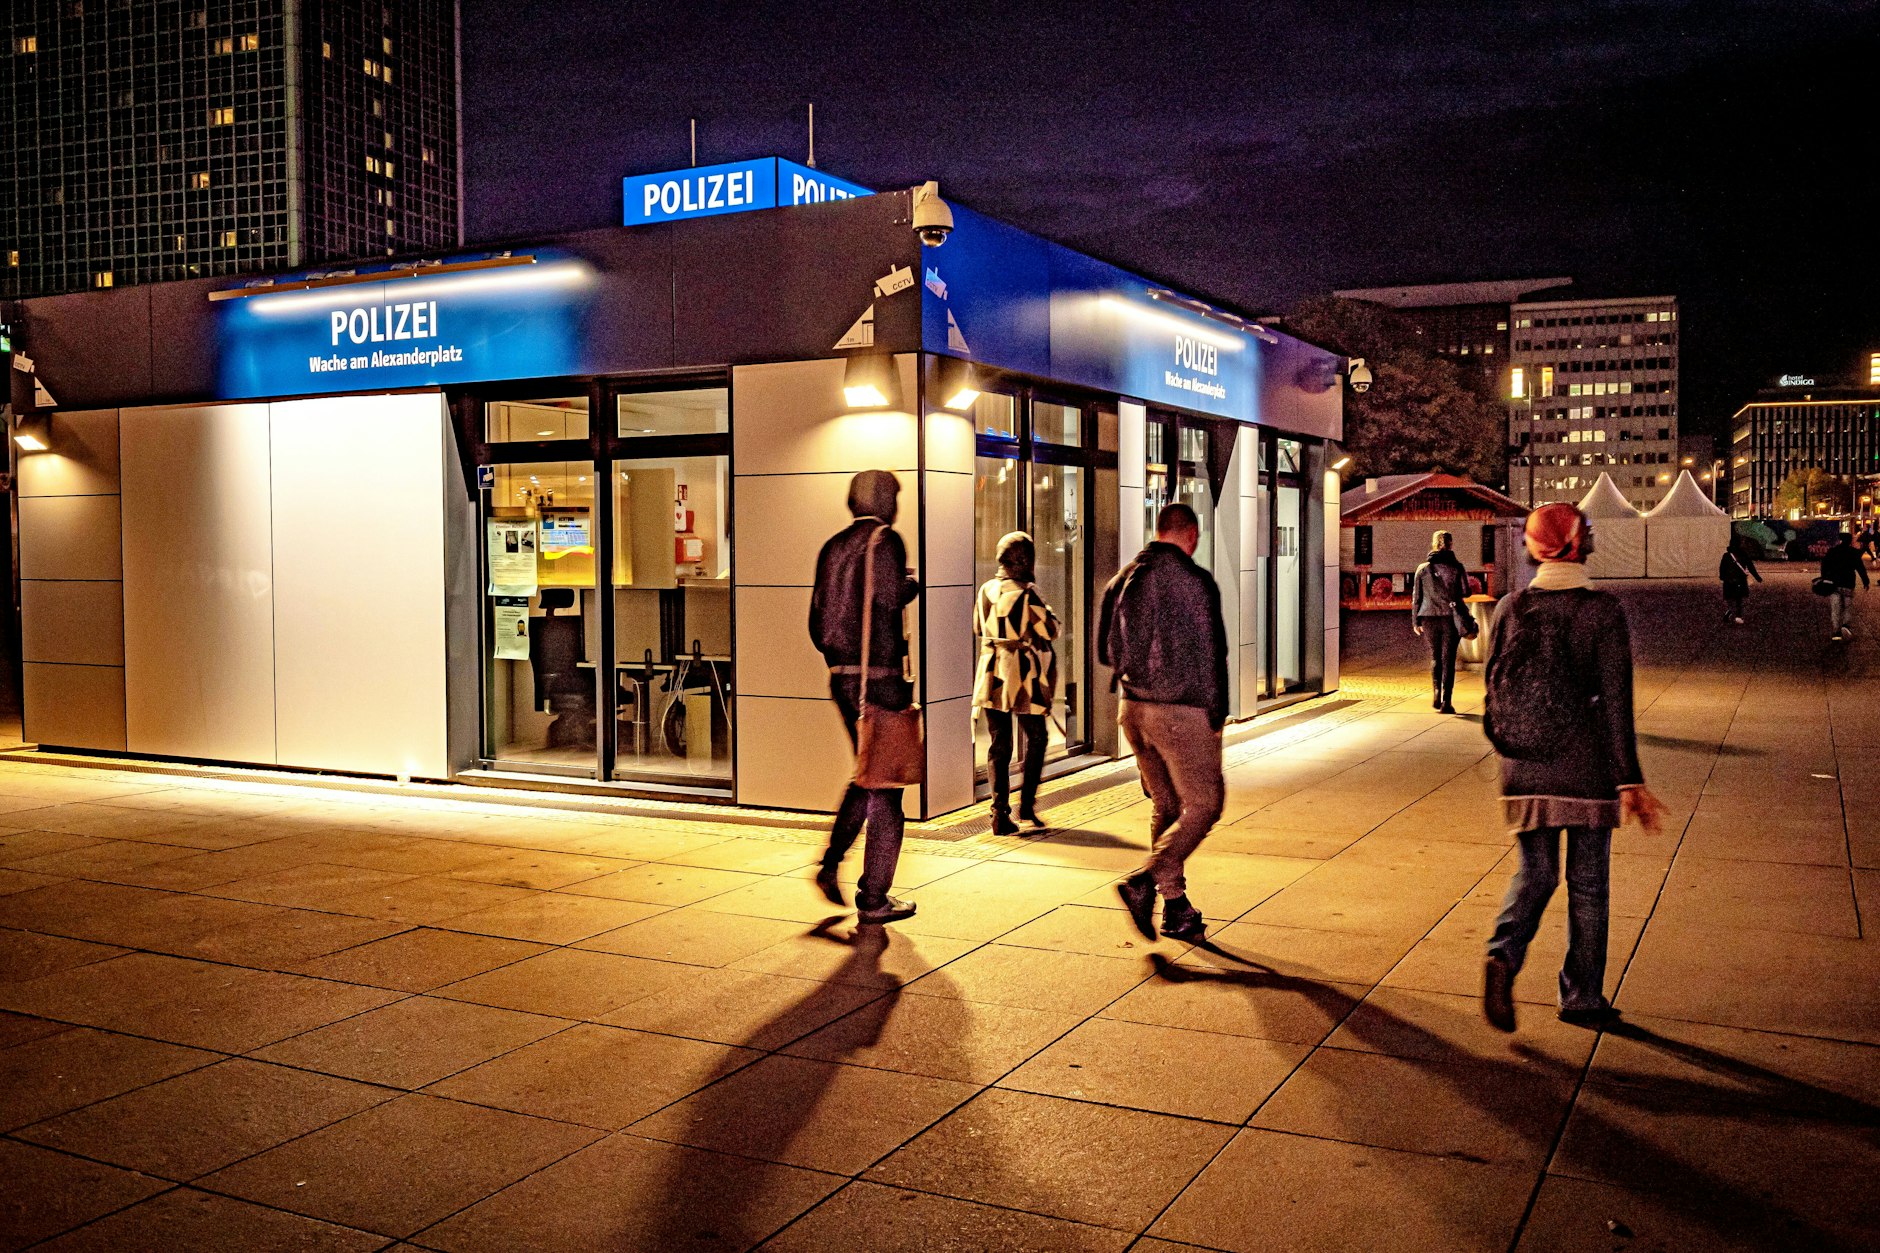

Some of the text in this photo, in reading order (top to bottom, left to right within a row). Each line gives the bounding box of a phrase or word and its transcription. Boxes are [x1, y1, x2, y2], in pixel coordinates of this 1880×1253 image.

[644, 170, 753, 217] POLIZEI
[892, 277, 912, 291] CCTV
[331, 300, 438, 346] POLIZEI
[309, 345, 463, 373] Wache am Alexanderplatz
[1175, 335, 1218, 376] POLIZEI
[1165, 370, 1226, 400] Wache am Alexanderplatz
